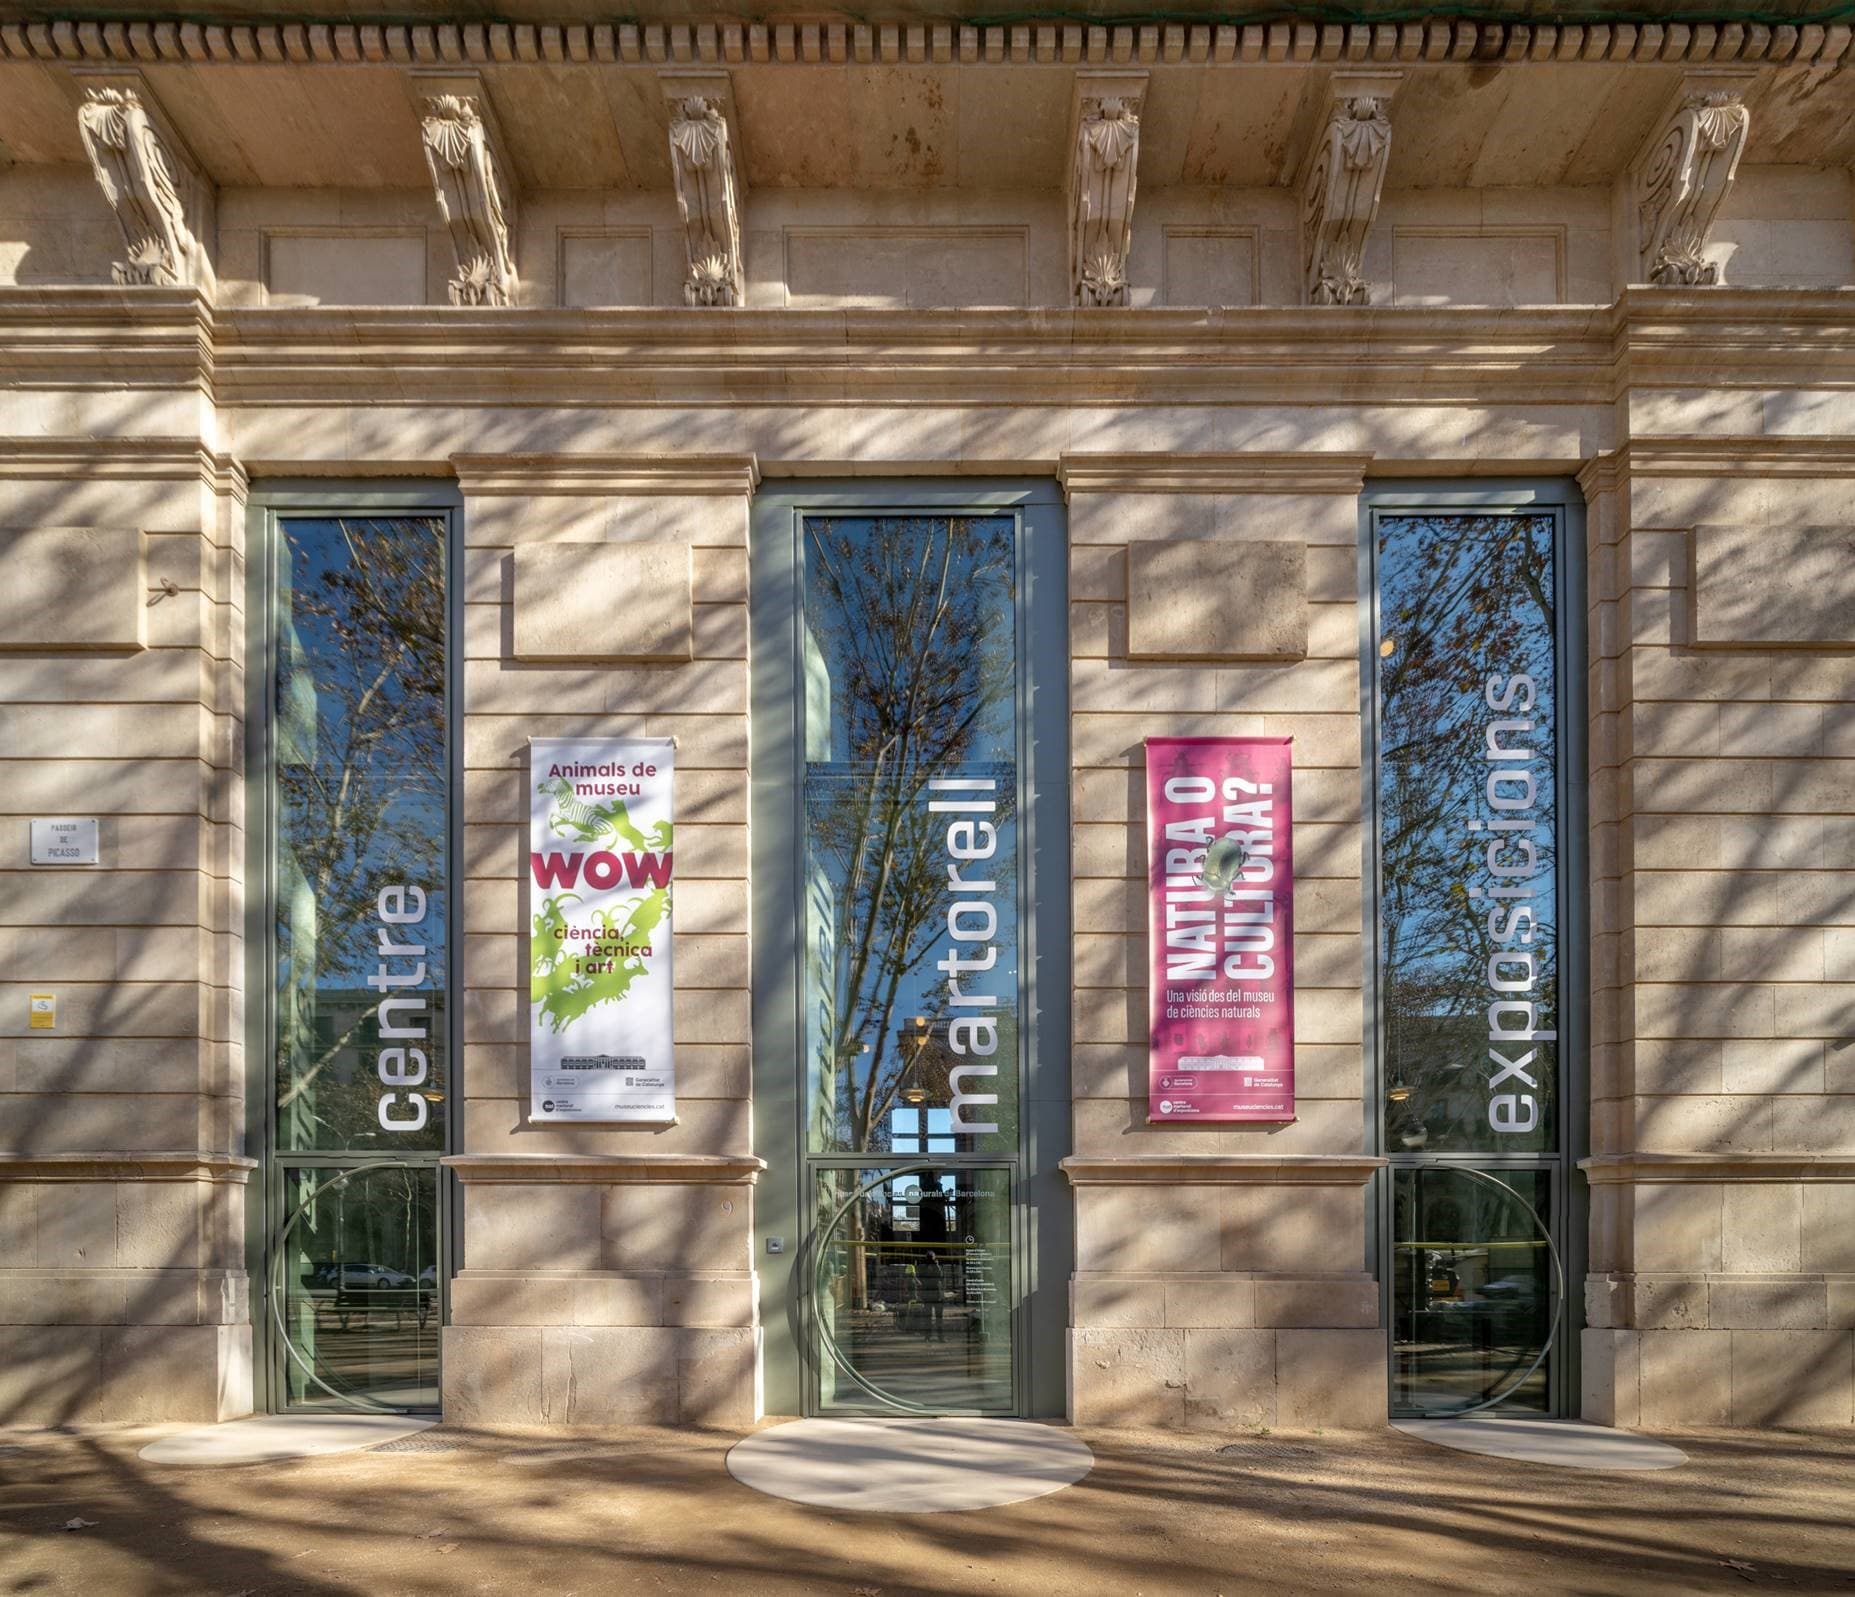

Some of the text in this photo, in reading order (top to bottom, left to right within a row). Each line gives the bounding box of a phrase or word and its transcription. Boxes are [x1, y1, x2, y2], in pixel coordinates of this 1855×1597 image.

[549, 761, 656, 777] Animals de
[575, 783, 640, 796] museu
[48, 848, 80, 857] PICASSO
[531, 851, 673, 890] WOW
[1165, 776, 1216, 980] NATURA O
[1468, 673, 1556, 1132] exposicions
[554, 925, 624, 942] ciència,
[585, 943, 652, 957] tècnica
[928, 779, 998, 1133] martorell
[575, 960, 614, 974] i art
[1166, 989, 1274, 1003] Una visió des del museu
[367, 885, 427, 1132] centre
[1166, 1006, 1260, 1019] de ciències naturals
